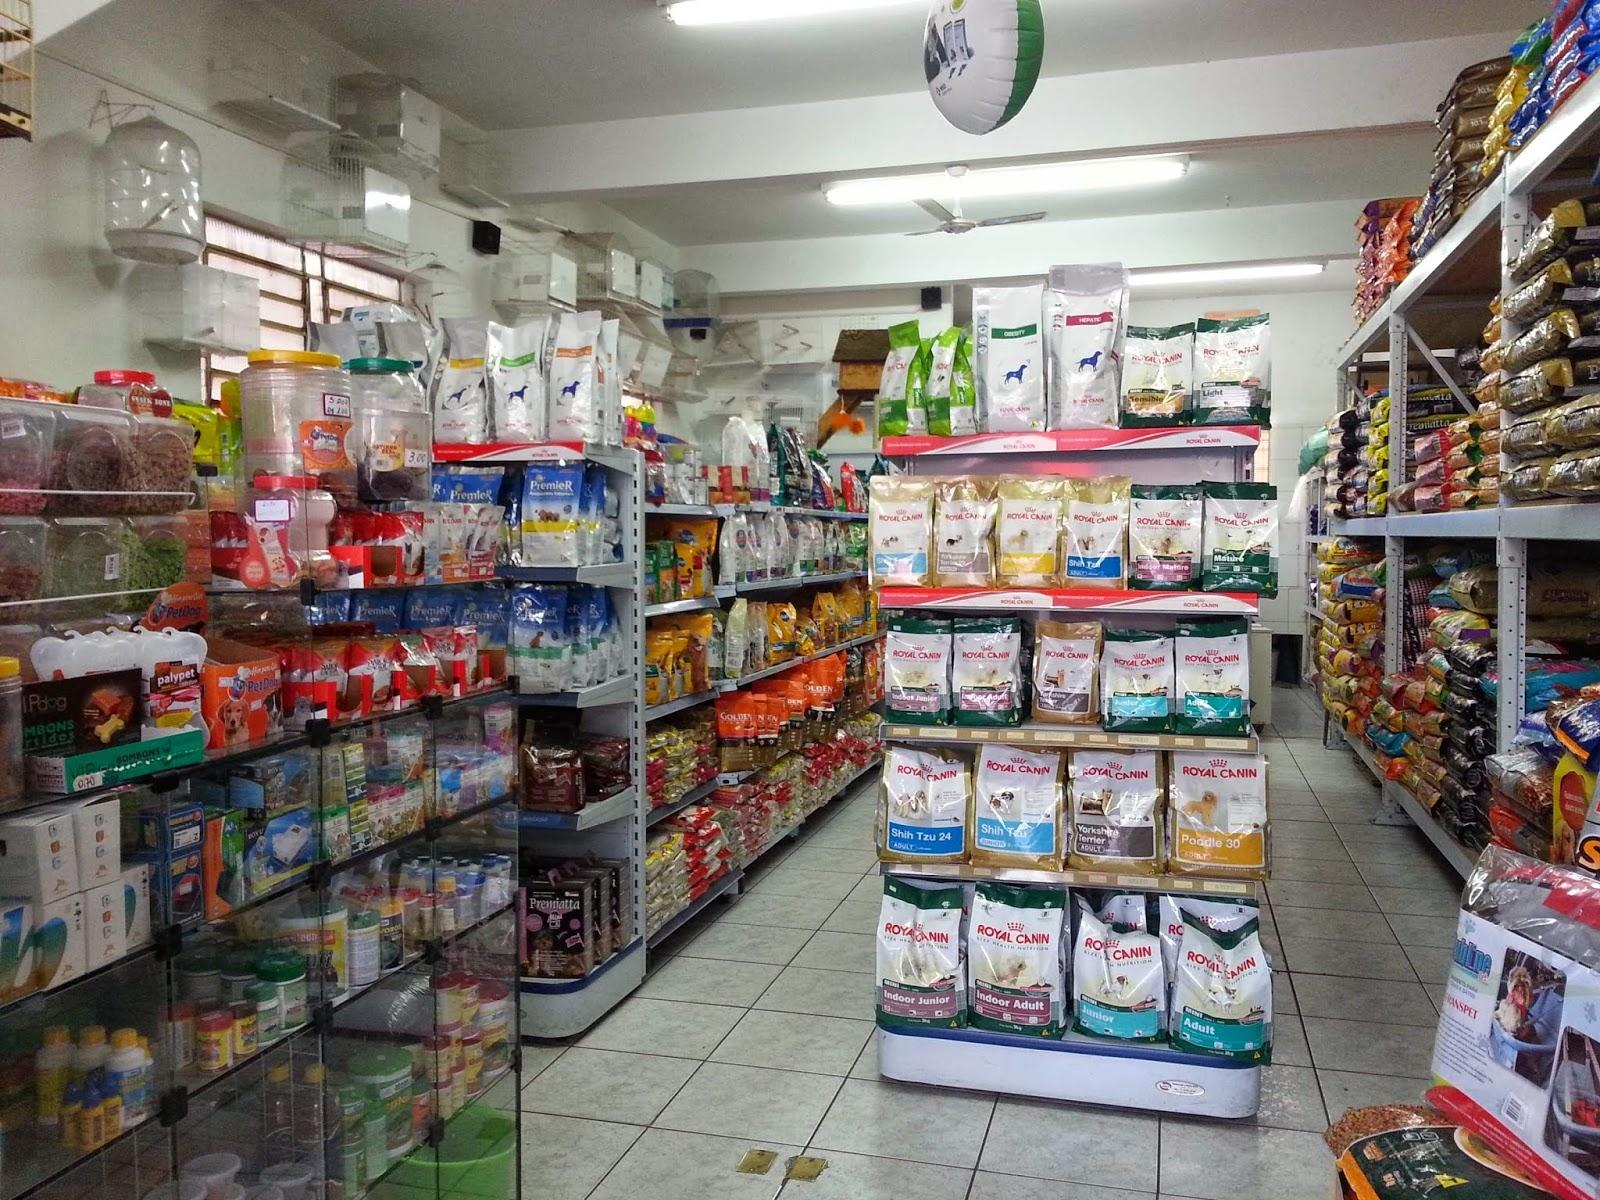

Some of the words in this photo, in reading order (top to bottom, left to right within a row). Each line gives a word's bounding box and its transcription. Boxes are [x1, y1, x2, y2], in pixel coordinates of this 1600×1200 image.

[1202, 389, 1223, 398] Light
[878, 514, 901, 522] ROYAL
[901, 513, 923, 522] CANIN
[1007, 513, 1030, 521] ROYAL
[1030, 513, 1053, 521] CANIN
[1074, 514, 1095, 524] ROYAL
[1096, 514, 1118, 524] CANIN
[1136, 517, 1162, 526] ROYAL
[1214, 516, 1239, 526] ROYAL
[1214, 554, 1244, 563] Mature
[892, 650, 916, 659] ROYAL
[918, 651, 942, 660] CANIN
[962, 651, 986, 659] ROYAL
[988, 650, 1010, 659] CANIN
[1045, 650, 1067, 659] ROYAL
[1068, 652, 1088, 660] CANIN
[1184, 654, 1209, 664] ROYAL
[1212, 655, 1240, 664] CANIN
[1114, 658, 1139, 667] ROYAL
[1140, 656, 1165, 667] CANIN
[157, 668, 196, 688] palypet
[720, 711, 752, 722] GOLDEN
[897, 764, 925, 780] ROYAL
[926, 770, 958, 782] CANIN
[986, 760, 1015, 773] ROYAL
[1018, 765, 1050, 776] CANIN
[1082, 766, 1113, 778] ROYAL
[1116, 770, 1148, 781] CANIN
[1182, 766, 1218, 778] ROYAL
[1220, 768, 1257, 779] CANIN
[891, 828, 914, 841] Shih
[918, 832, 936, 842] Tzu
[938, 832, 952, 841] 24
[981, 824, 1004, 836] Shih
[1077, 824, 1120, 838] Yorkshire
[1077, 836, 1106, 846] Terrier
[1181, 834, 1223, 849] Poodle
[1226, 838, 1241, 849] 30
[529, 898, 580, 910] Premiatta
[977, 924, 1012, 943] ROYAL
[1016, 932, 1050, 944] CANIN
[1112, 946, 1152, 961] CANIN
[1188, 950, 1221, 973] ROYAL
[1224, 957, 1256, 980] CANIN
[884, 990, 916, 1004] Indoor
[918, 996, 950, 1005] Junior
[976, 990, 1010, 1006] Indoor
[1013, 998, 1045, 1011] Adult
[1081, 1004, 1114, 1024] Junior
[1185, 1006, 1203, 1018] MINI
[1184, 1018, 1216, 1035] Adult
